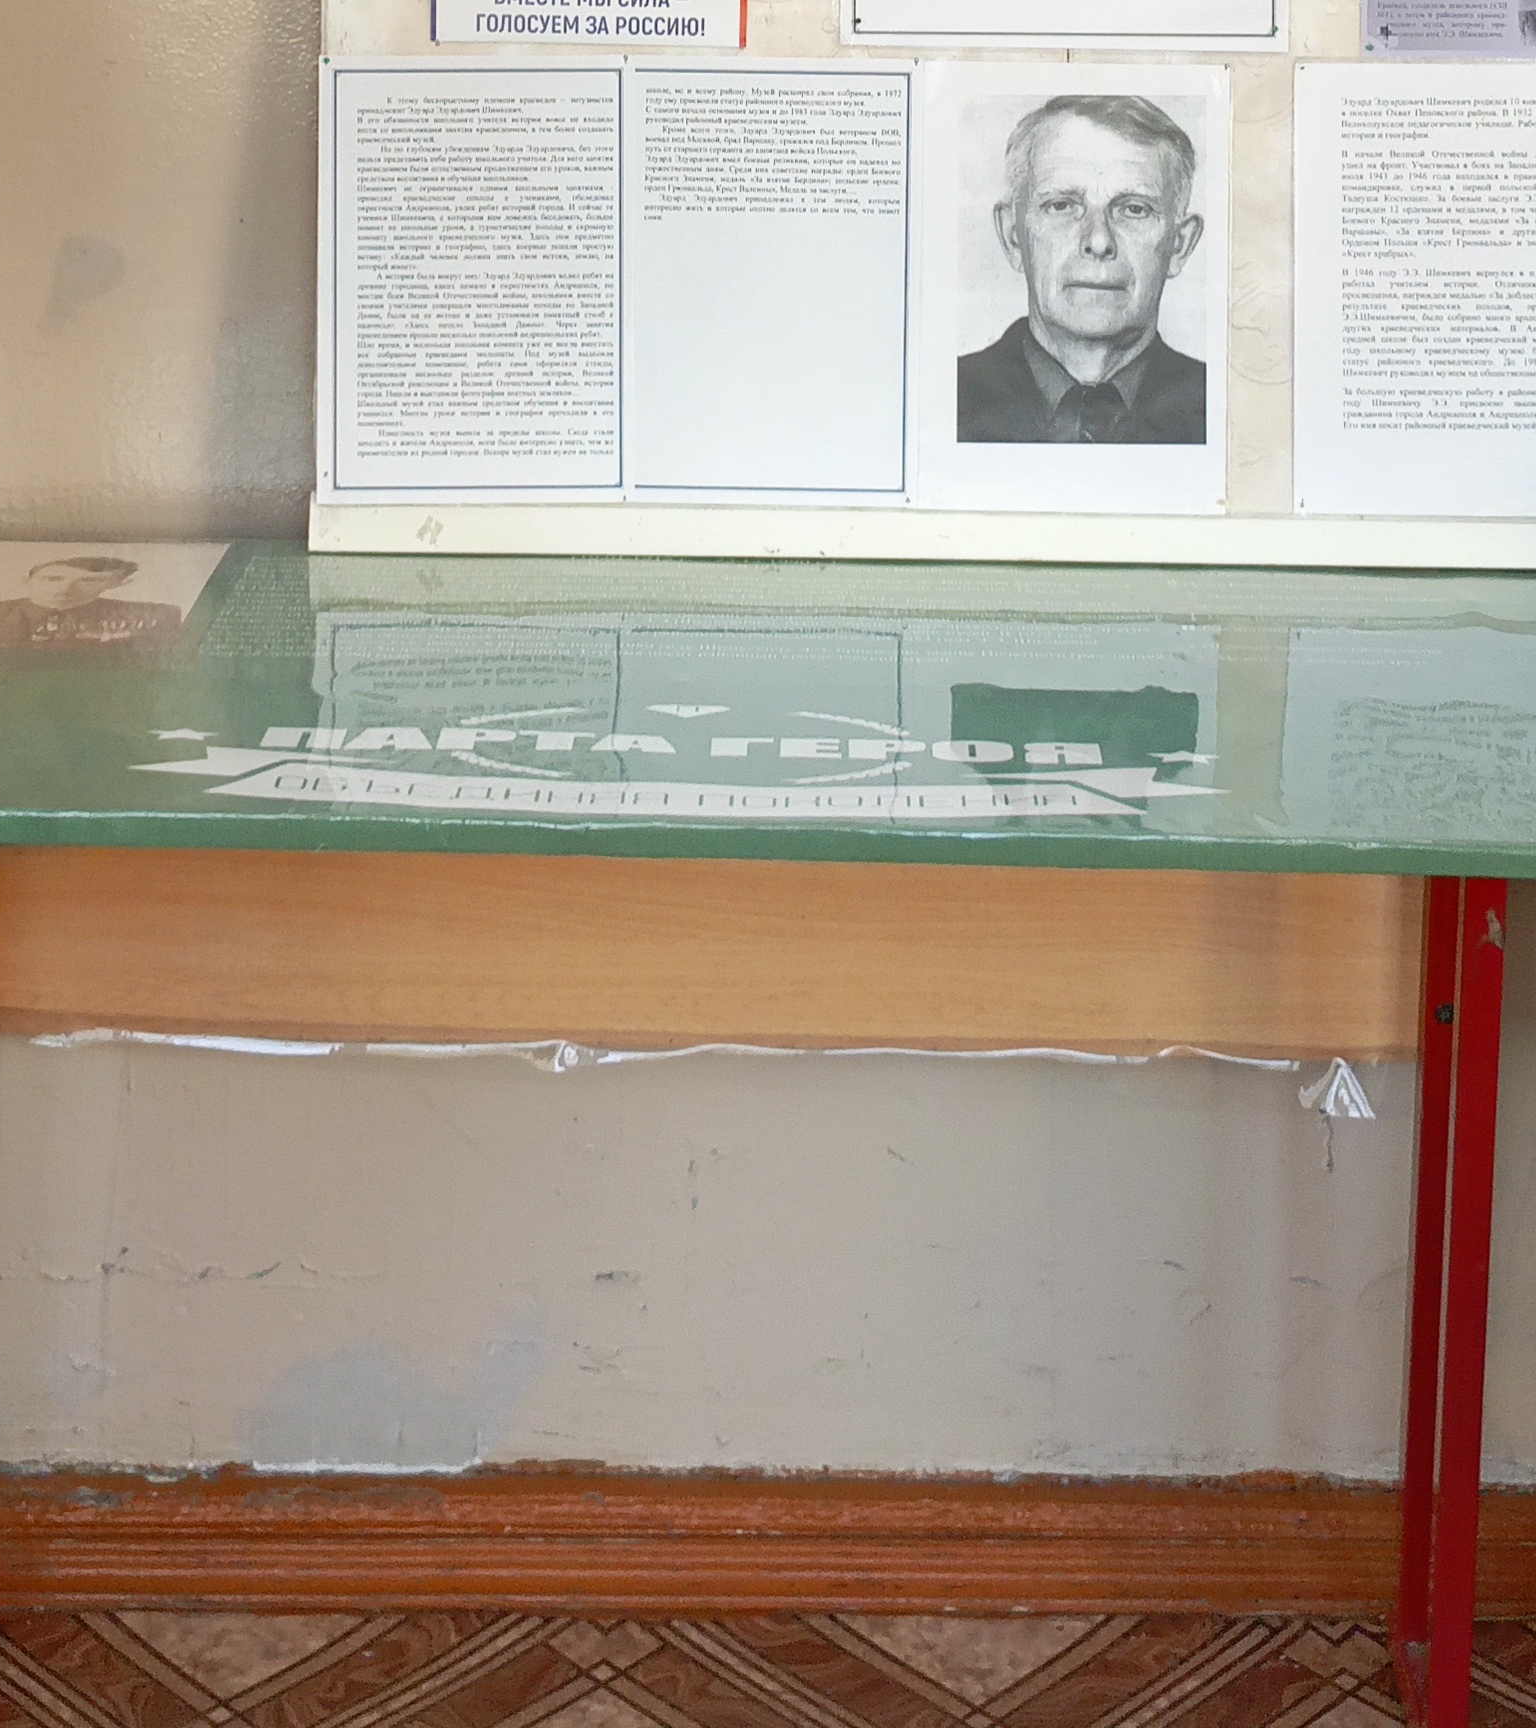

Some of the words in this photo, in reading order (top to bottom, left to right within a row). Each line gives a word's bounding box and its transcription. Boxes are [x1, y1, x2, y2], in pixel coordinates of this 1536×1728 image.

[476, 13, 580, 34] ГОЛОСУЕМ
[585, 16, 609, 35] ЗА
[615, 16, 706, 37] РОССИЮ!
[259, 726, 676, 754] ПАРТА
[711, 736, 1104, 765] ГЕРОЯ
